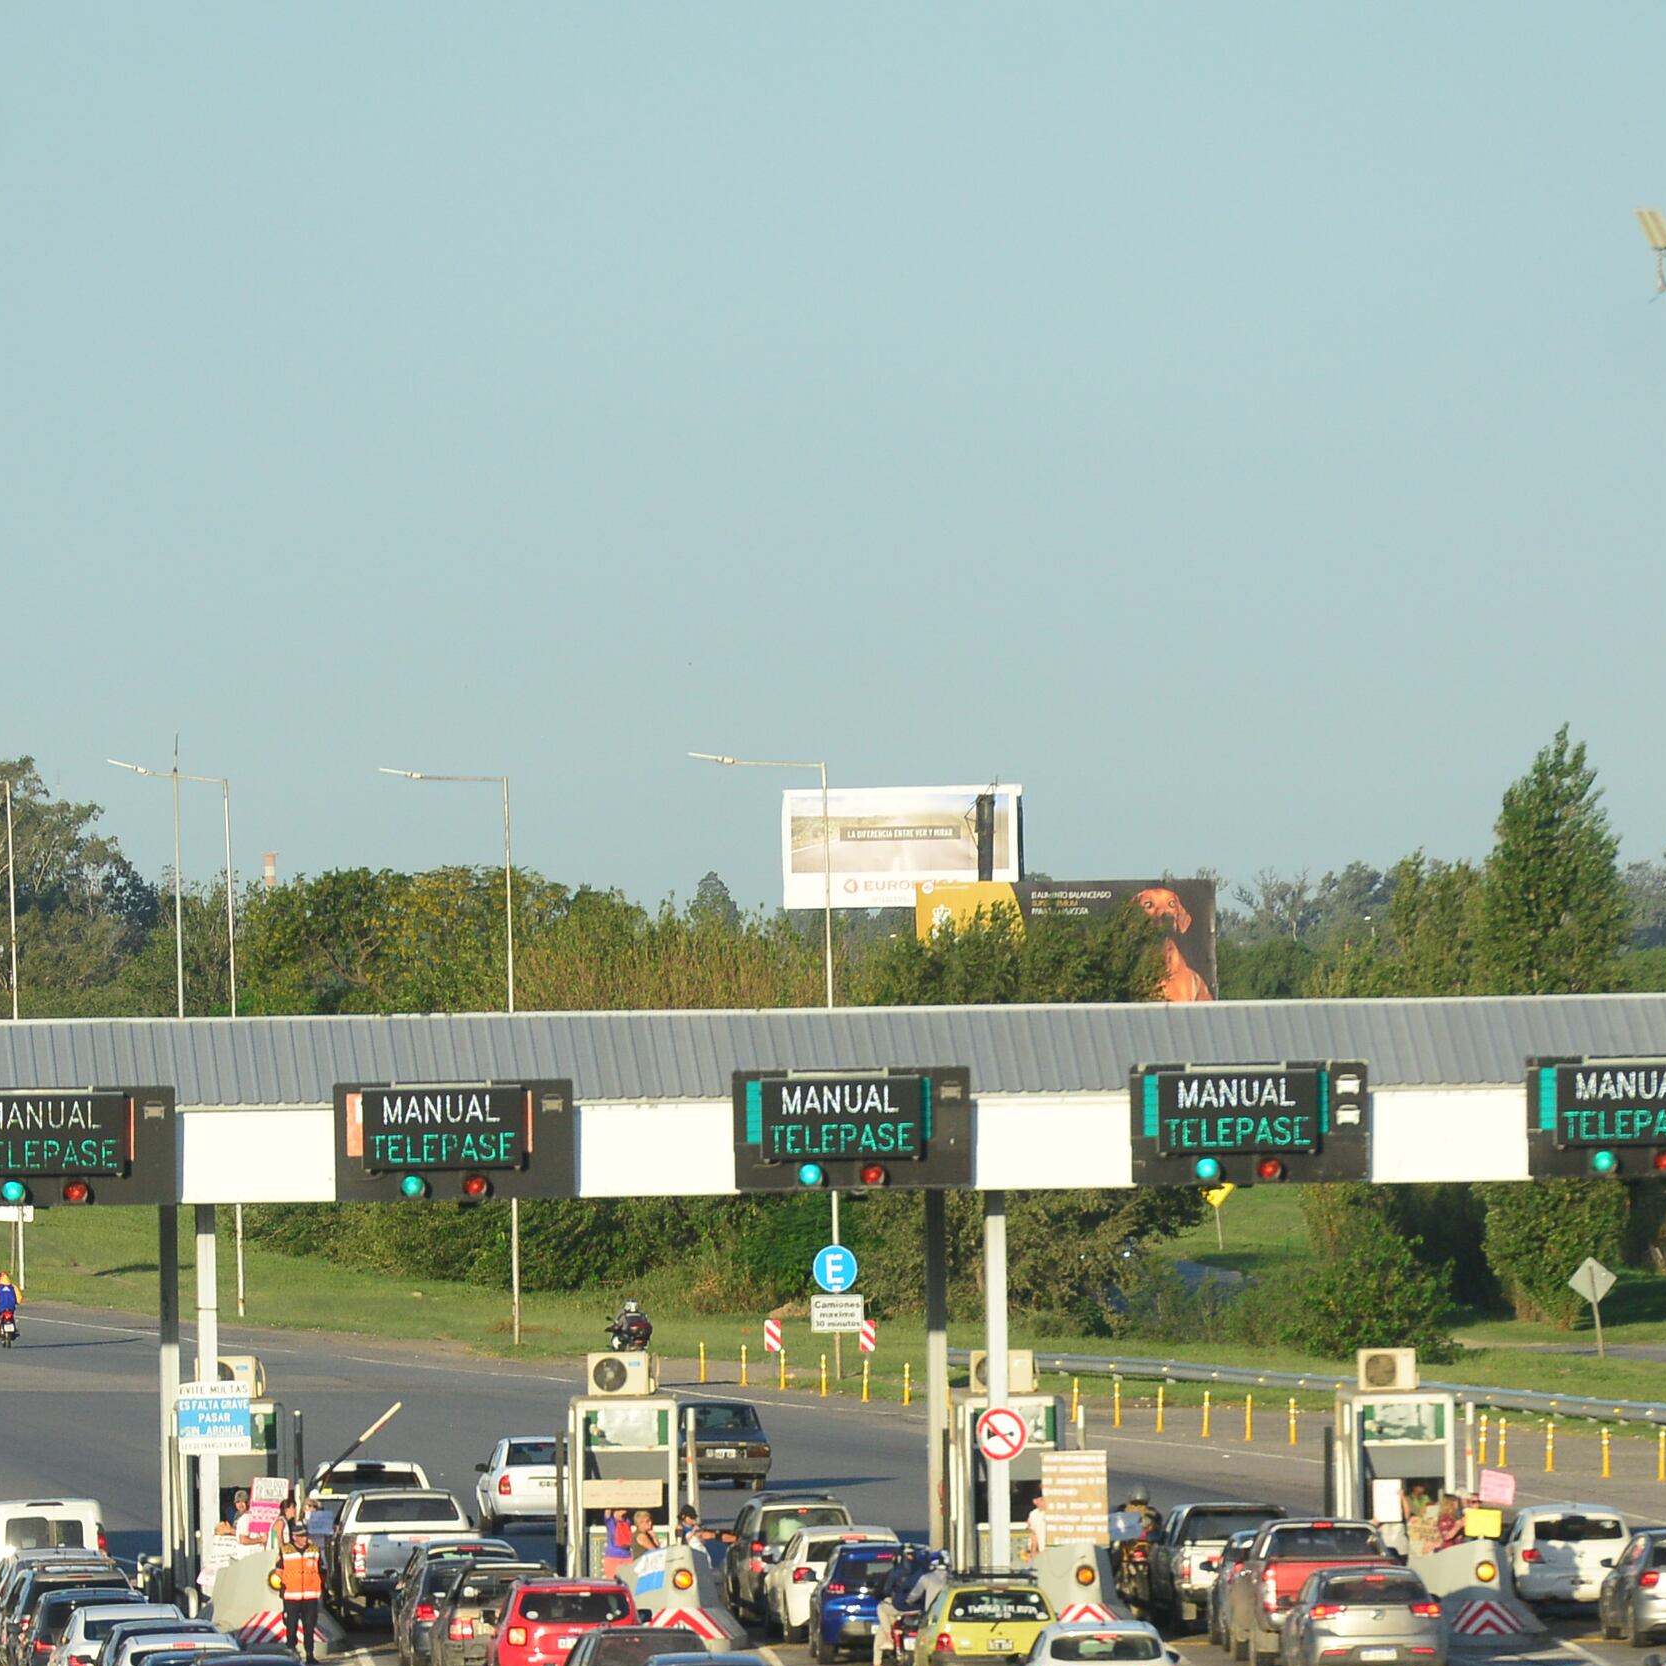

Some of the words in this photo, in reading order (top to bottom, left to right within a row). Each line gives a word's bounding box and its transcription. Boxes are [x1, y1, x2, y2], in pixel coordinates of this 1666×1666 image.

[781, 1085, 900, 1116] MANUAL
[1177, 1078, 1296, 1110] MANUAL
[381, 1094, 501, 1126] MANUAL
[769, 1122, 916, 1155] TELEPASE
[1163, 1115, 1312, 1149] TELEPASE
[369, 1131, 515, 1165] TELEPASE
[825, 1253, 845, 1284] E
[814, 1301, 861, 1309] Camiones
[827, 1320, 861, 1328] minutos
[179, 1385, 204, 1395] EVITE
[210, 1384, 248, 1394] MULTAS
[179, 1400, 191, 1411] ES
[191, 1400, 220, 1411] FALTA
[220, 1399, 249, 1410] GRAVE
[198, 1412, 231, 1424] PASAR
[206, 1425, 244, 1437] ABONAR
